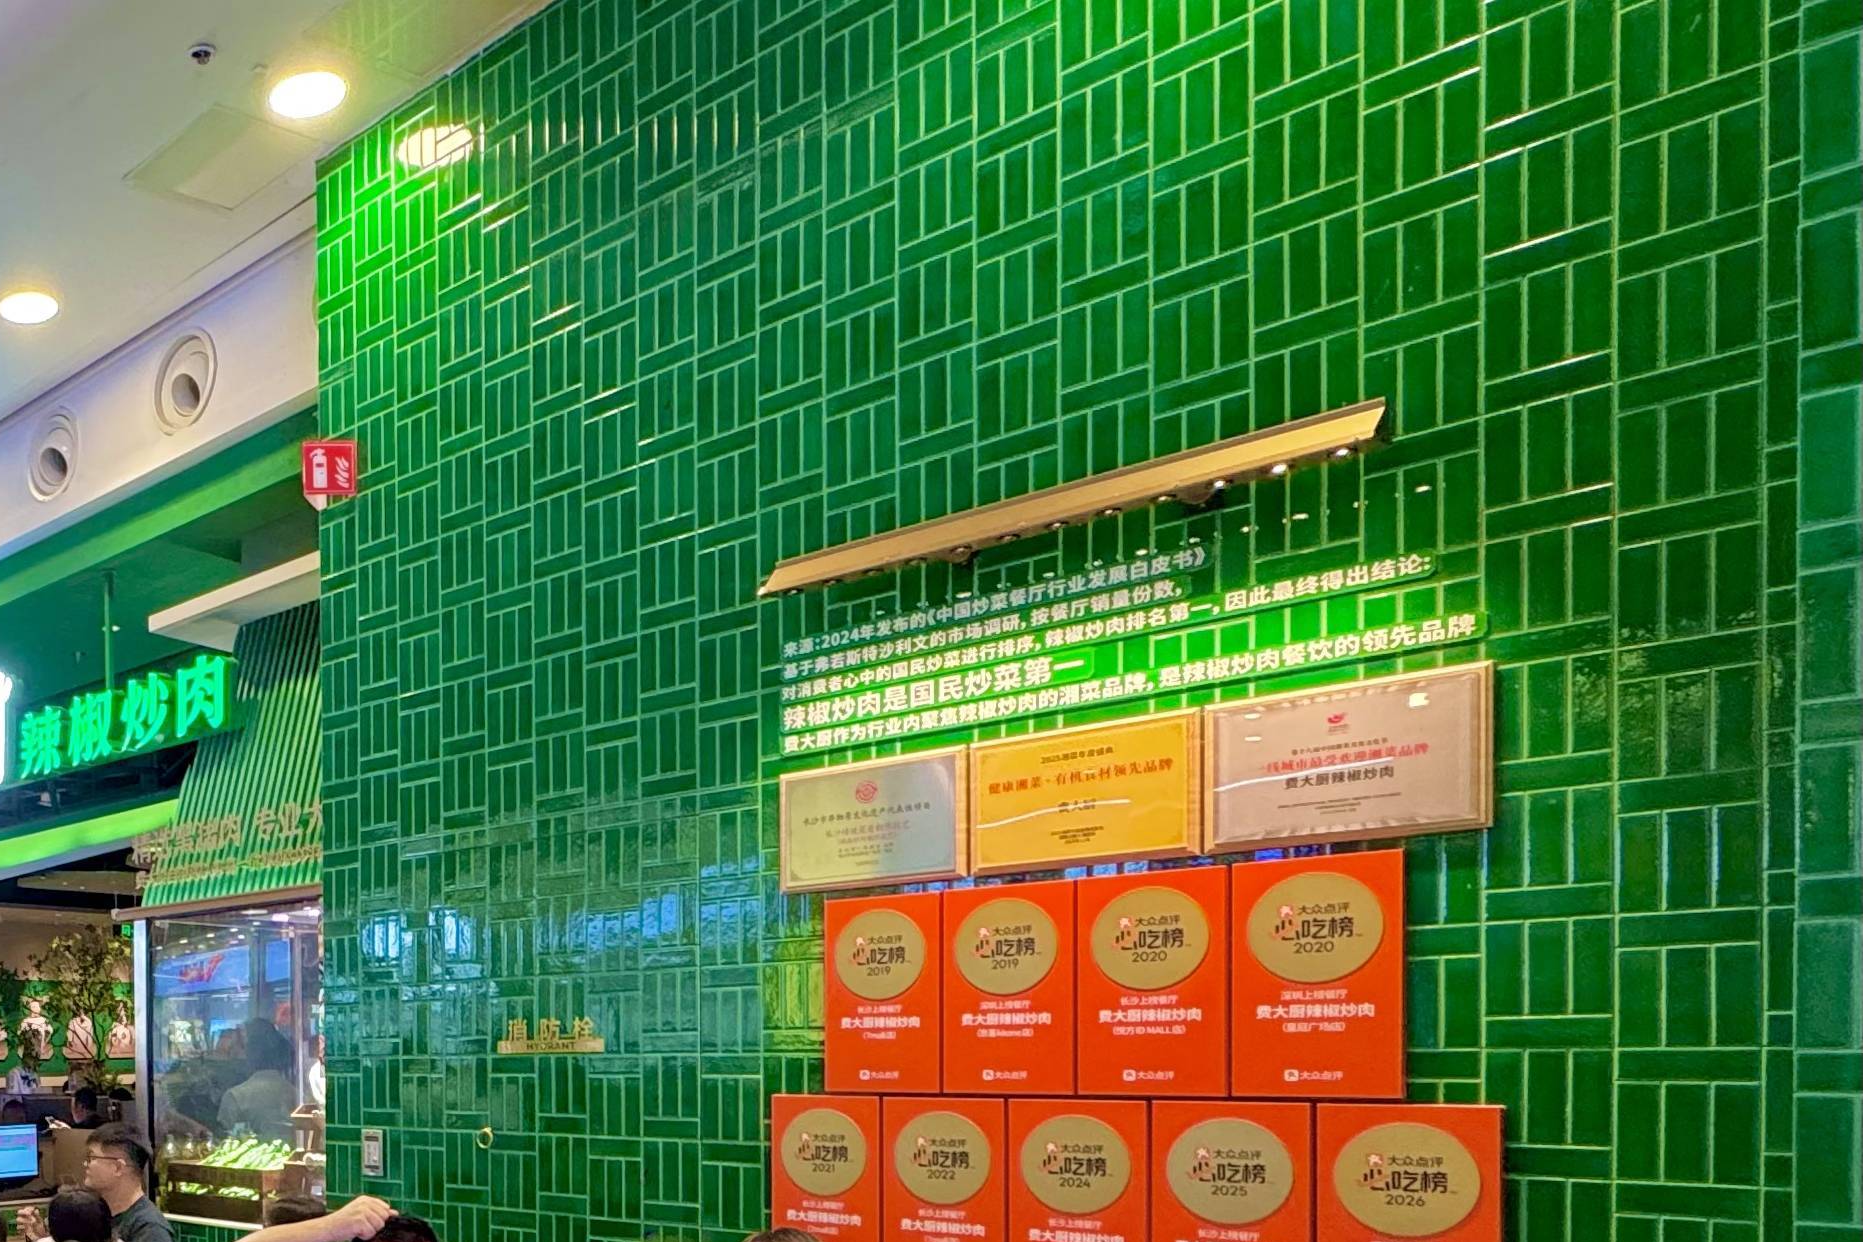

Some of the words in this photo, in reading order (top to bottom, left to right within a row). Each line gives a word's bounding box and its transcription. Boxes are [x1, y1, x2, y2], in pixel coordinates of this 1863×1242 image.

[783, 656, 1085, 730] 辣椒炒肉是国民炒菜第一
[20, 655, 226, 779] 辣椒炒肉
[1298, 902, 1350, 915] 大众点评
[1136, 915, 1180, 927] 大众点评
[992, 925, 1032, 937] 大众点评
[1273, 916, 1355, 940] 必吃榜
[867, 935, 903, 946] 大众点评
[1113, 928, 1184, 950] 必吃榜
[973, 937, 1037, 958] 必吃榜
[1293, 941, 1334, 954] 2020
[850, 946, 906, 965] 必吃榜
[1131, 951, 1167, 963] 2020
[992, 959, 1019, 970] 2019
[866, 966, 892, 977] 2019
[1256, 1003, 1375, 1019] 费大厨辣椒炒肉
[508, 1015, 595, 1041] 消防栓
[796, 1143, 849, 1163] 必吃榜
[1060, 1144, 1103, 1154] 大众点评
[1212, 1149, 1262, 1161] 大众点评
[911, 1148, 970, 1169] 必吃榜
[1388, 1155, 1442, 1168] 大众点评
[811, 1163, 836, 1173] 2021
[1040, 1154, 1107, 1177] 必吃榜
[927, 1169, 956, 1180] 2022
[1191, 1161, 1267, 1184] 必吃榜
[1059, 1177, 1090, 1188] 2024
[1360, 1168, 1449, 1194] 必吃榜
[1210, 1185, 1248, 1197] 2025
[1385, 1194, 1426, 1207] 2026
